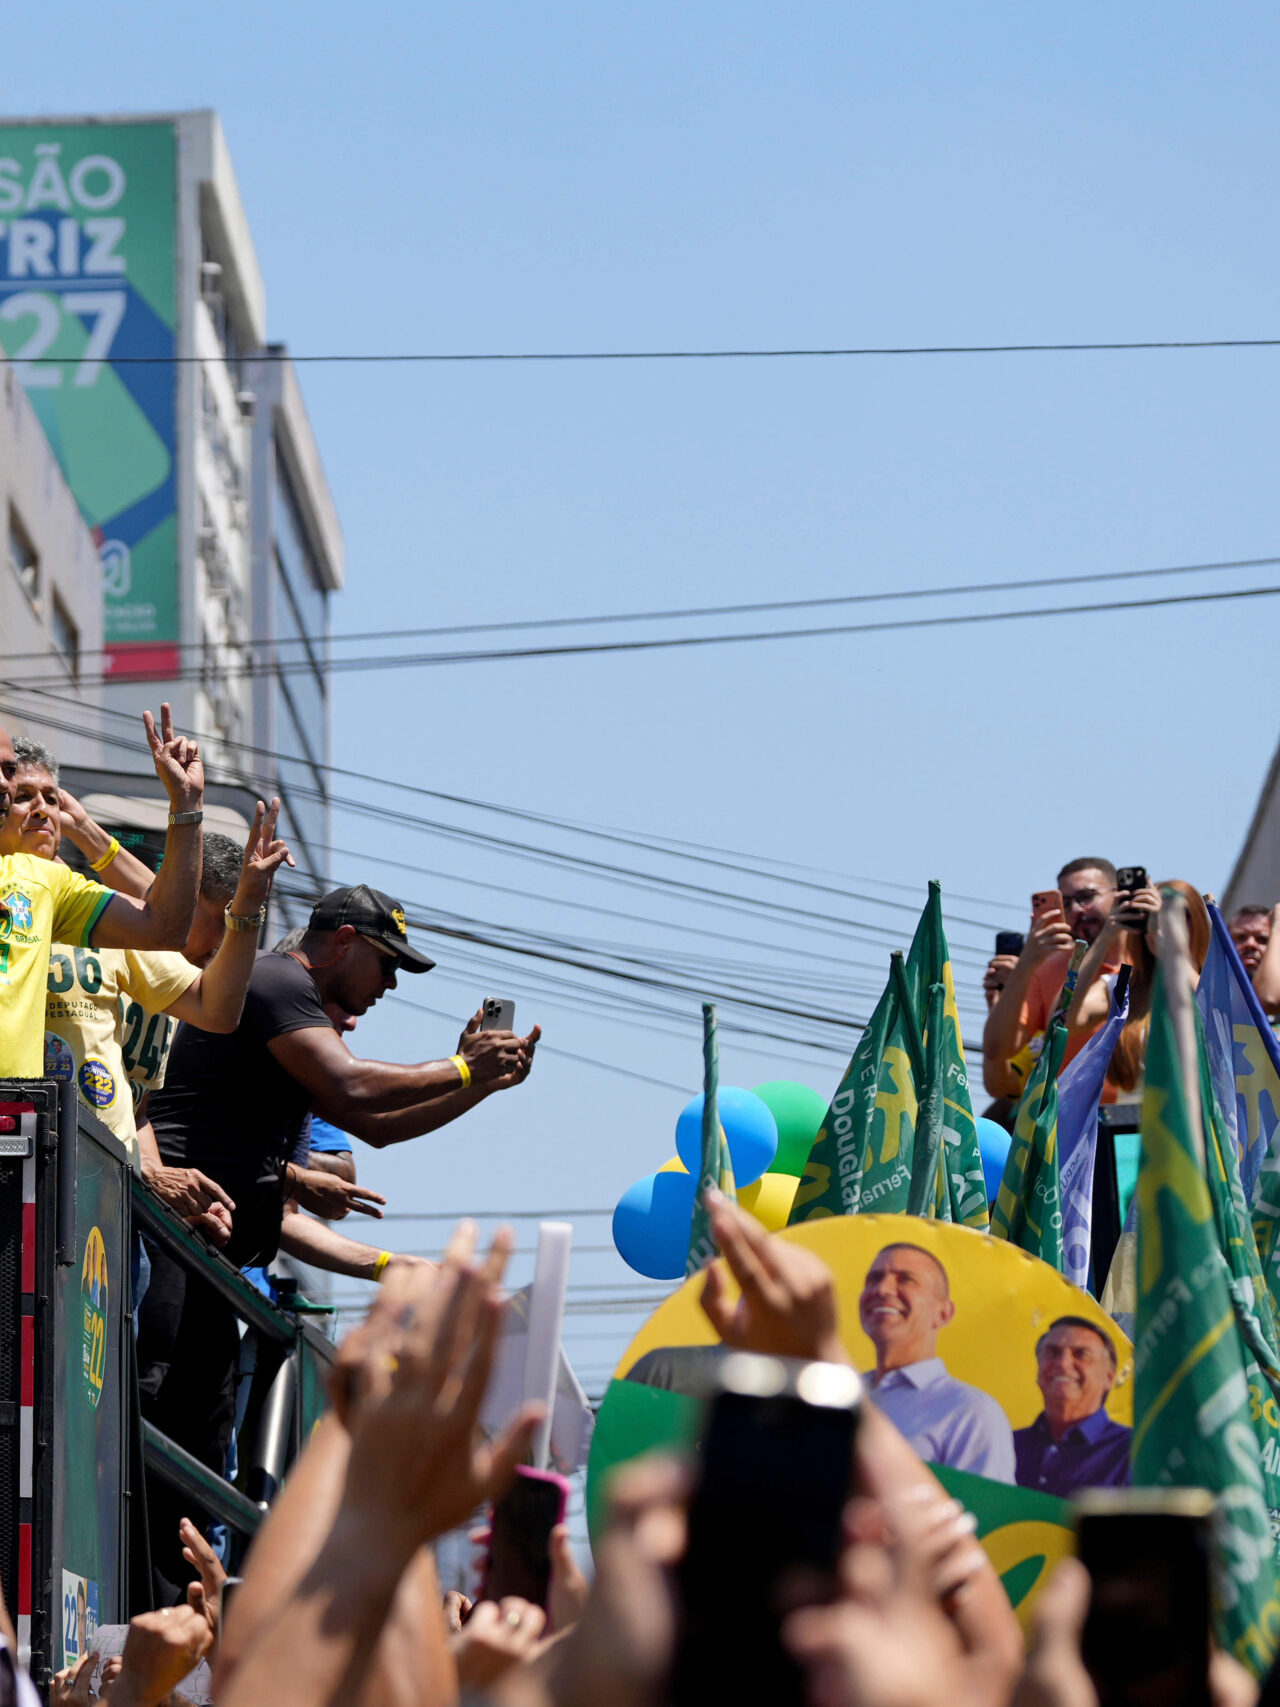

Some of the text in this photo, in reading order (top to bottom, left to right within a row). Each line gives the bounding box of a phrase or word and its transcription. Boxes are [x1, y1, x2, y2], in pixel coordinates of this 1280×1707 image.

[15, 935, 42, 944] BRASIL
[49, 1001, 98, 1012] DEPUTADO
[51, 1010, 98, 1021] ESTADUAL
[85, 1072, 112, 1094] 222
[89, 1311, 104, 1390] 22
[64, 1593, 78, 1654] 22
